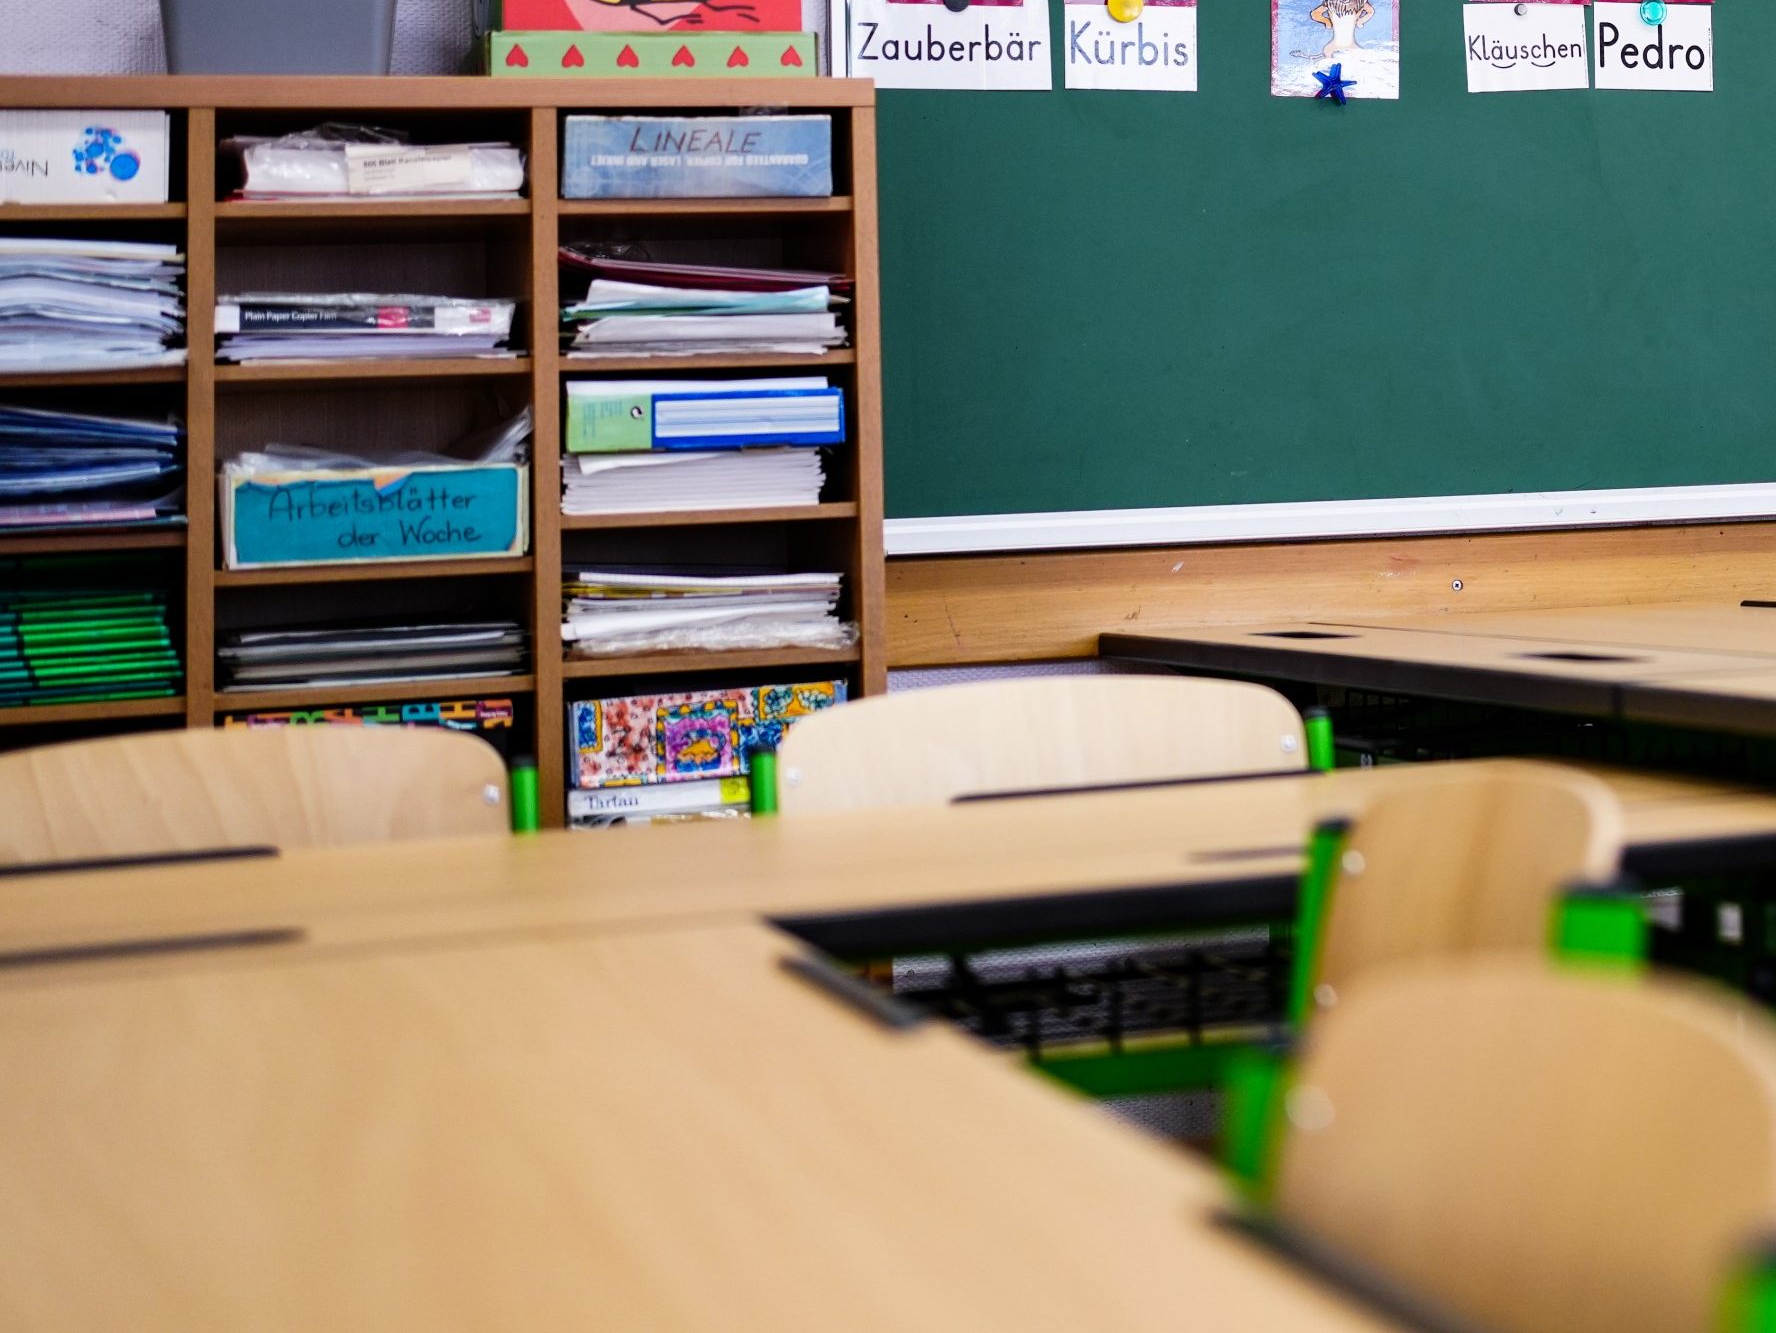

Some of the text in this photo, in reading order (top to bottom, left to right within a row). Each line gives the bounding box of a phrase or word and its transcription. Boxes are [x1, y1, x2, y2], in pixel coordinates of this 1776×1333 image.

[857, 22, 1041, 61] Zauberbär
[1070, 20, 1188, 67] Kürbis
[1469, 33, 1581, 60] Kläuschen
[1600, 22, 1705, 69] Pedro
[630, 126, 761, 153] LINEALE
[245, 312, 265, 321] Plain
[268, 312, 290, 323] Paper
[292, 312, 317, 322] Copier
[269, 487, 477, 521] Arbeitsblätter
[338, 516, 482, 548] der Woche
